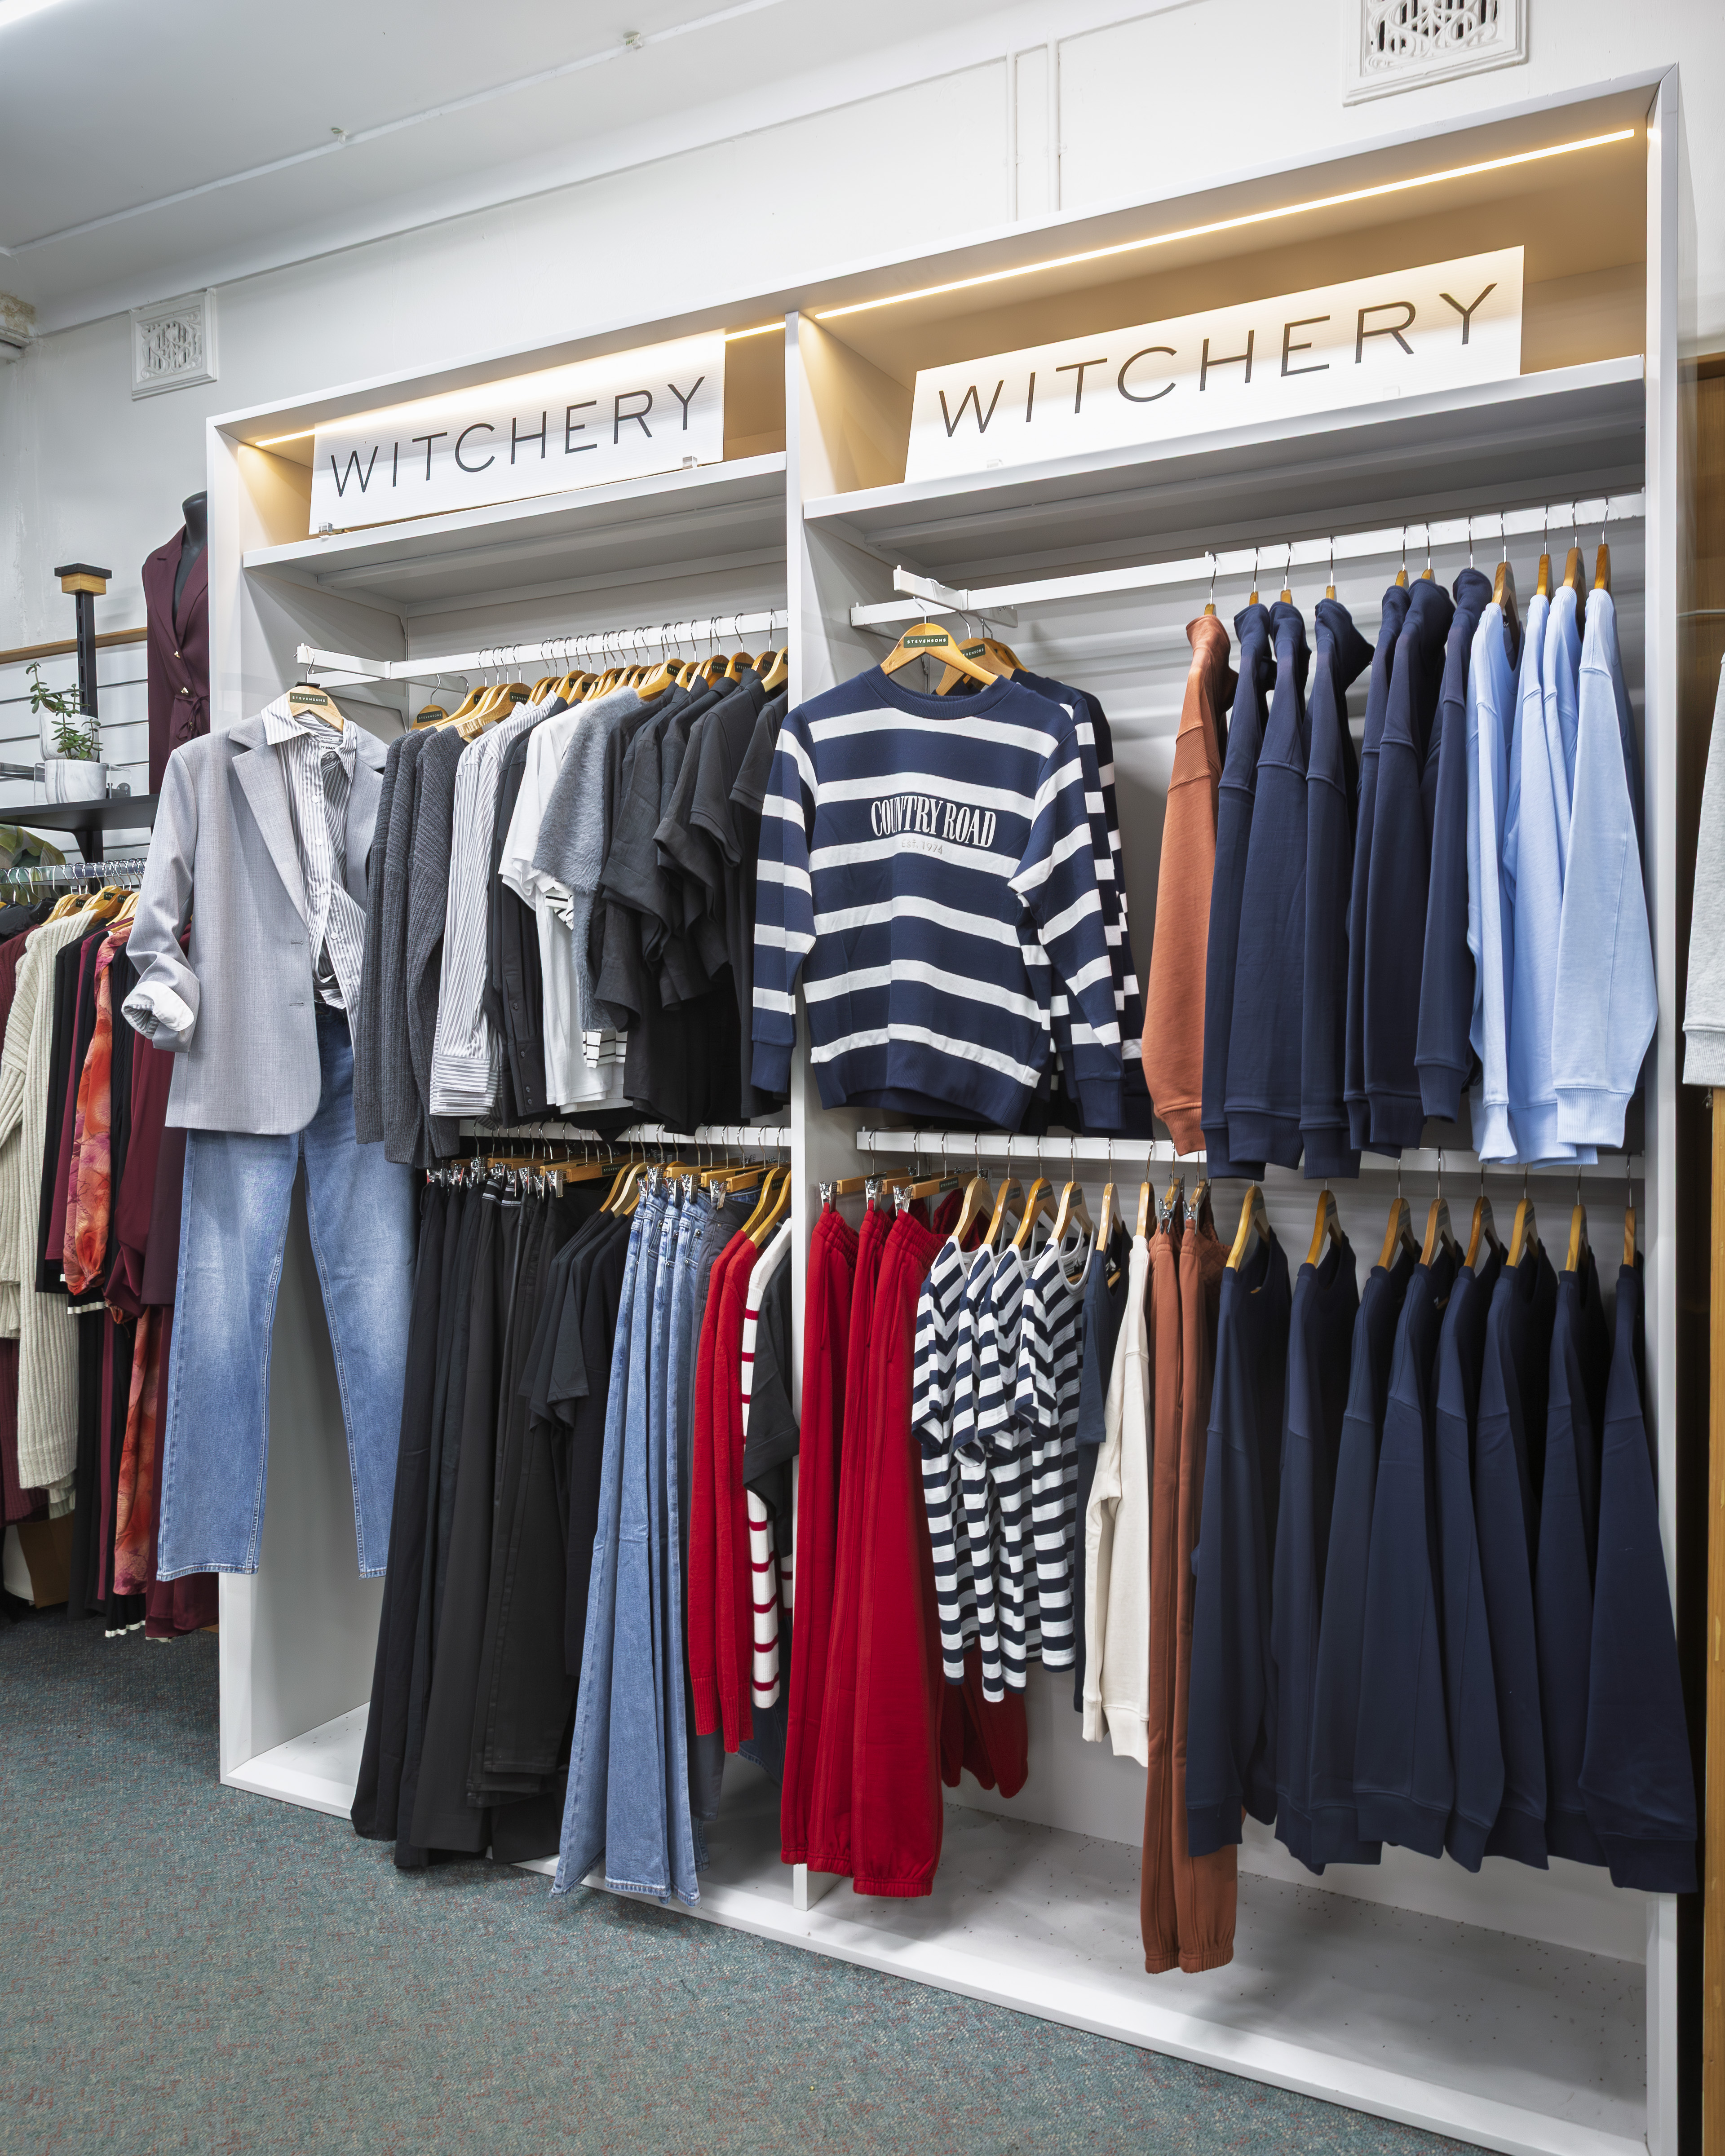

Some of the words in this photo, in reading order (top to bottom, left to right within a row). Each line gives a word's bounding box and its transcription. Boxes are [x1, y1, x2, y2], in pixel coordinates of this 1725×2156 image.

[939, 283, 1497, 437] WITCHERY
[331, 376, 705, 497] WITCHERY
[963, 648, 984, 656] EVENSONS
[871, 795, 943, 836] COUNTRY
[942, 802, 996, 848] ROAD
[921, 841, 943, 855] 1974
